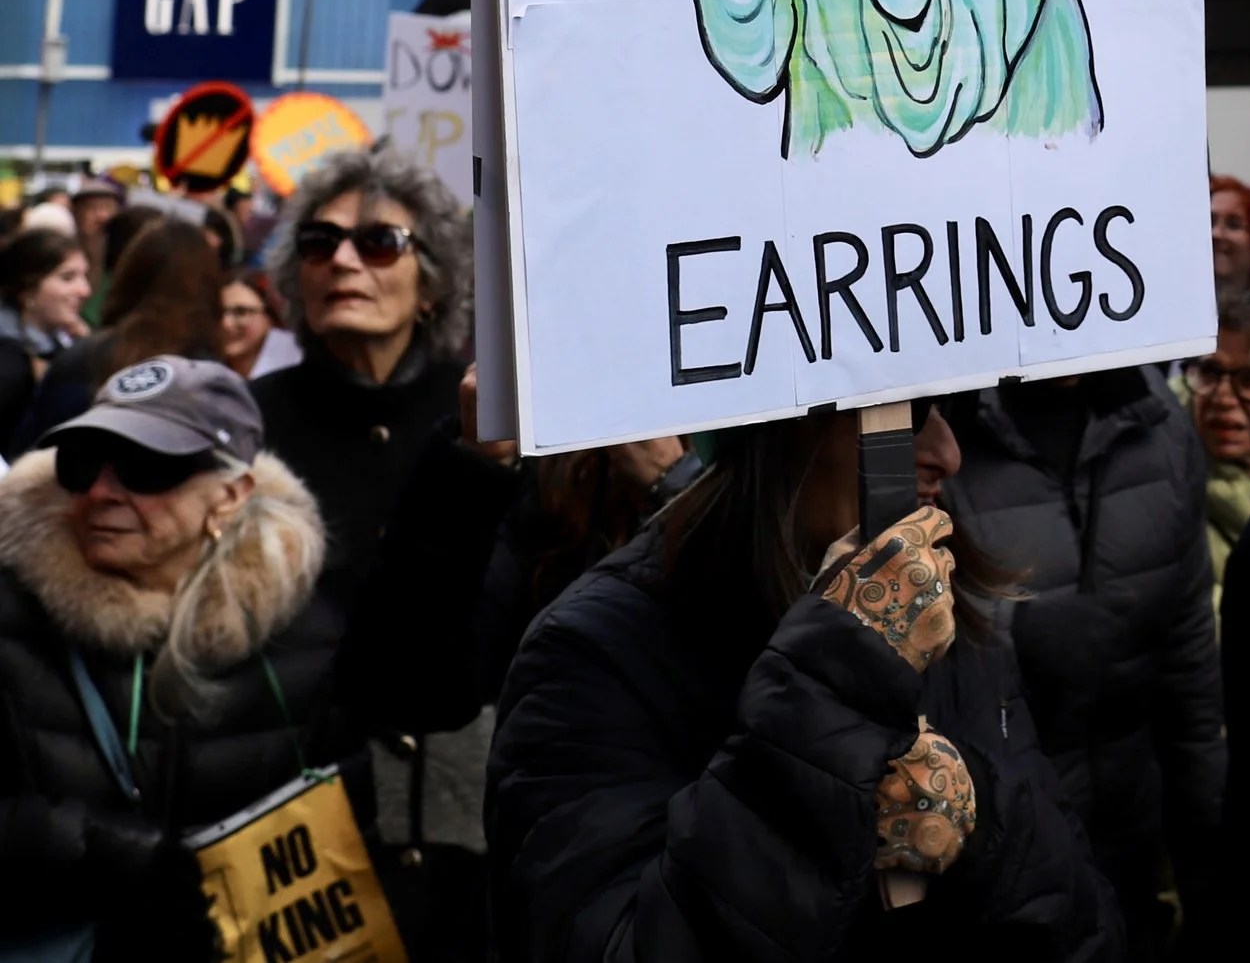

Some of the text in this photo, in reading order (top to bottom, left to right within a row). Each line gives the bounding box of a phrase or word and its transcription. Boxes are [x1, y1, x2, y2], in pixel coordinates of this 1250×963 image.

[665, 204, 1146, 387] EARRINGS
[260, 823, 317, 896] NO
[257, 878, 365, 963] KING
